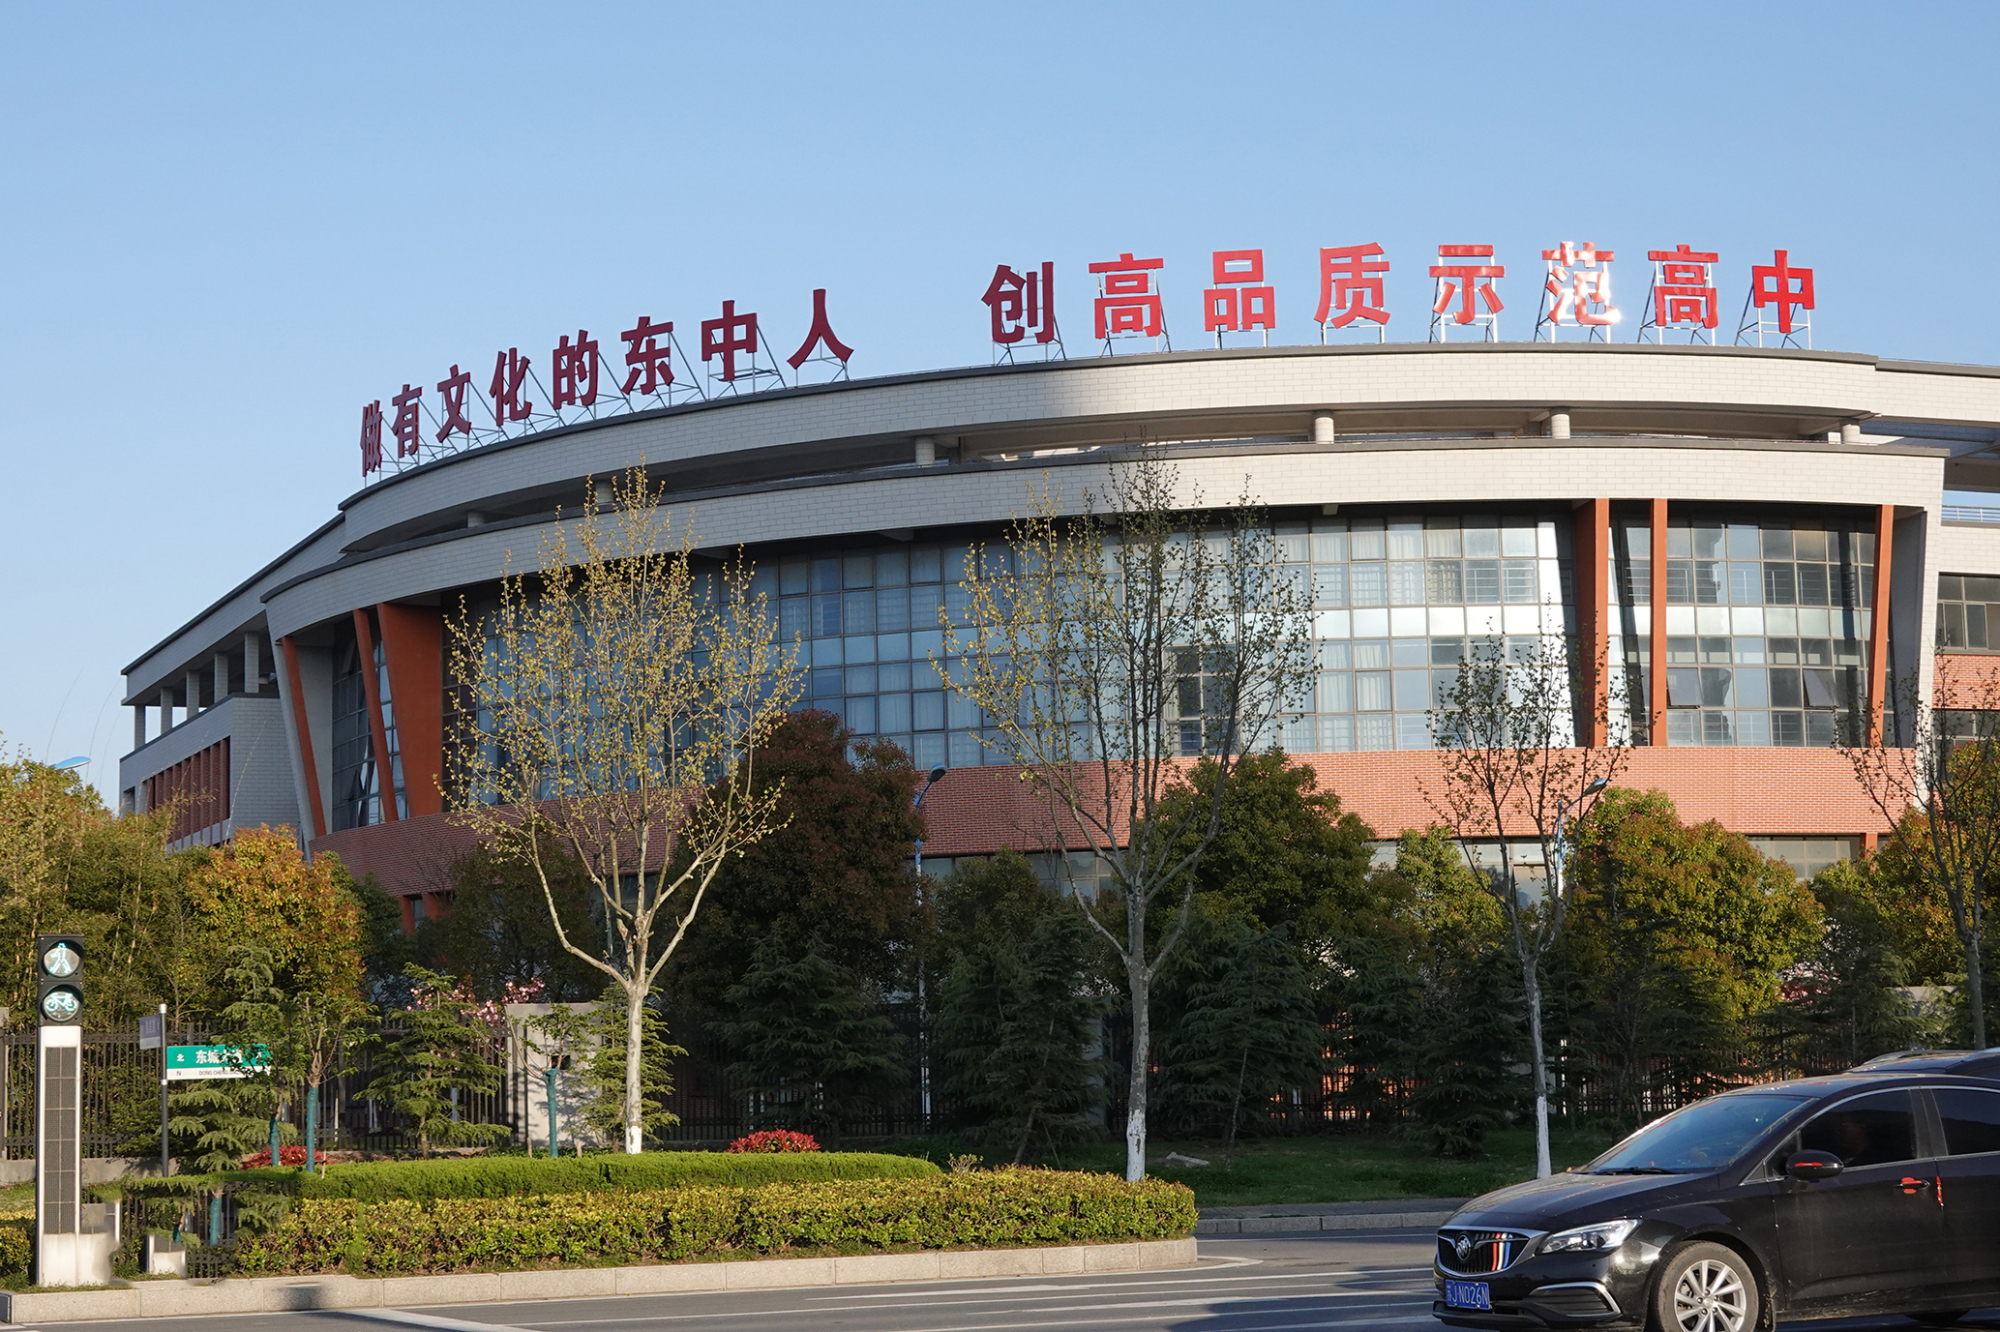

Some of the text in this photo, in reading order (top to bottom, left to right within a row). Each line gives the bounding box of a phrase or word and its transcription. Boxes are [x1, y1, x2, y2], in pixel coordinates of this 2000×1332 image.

[360, 241, 1815, 477] 做有文化的东中人 创高品质示范高中
[176, 1053, 185, 1062] 北
